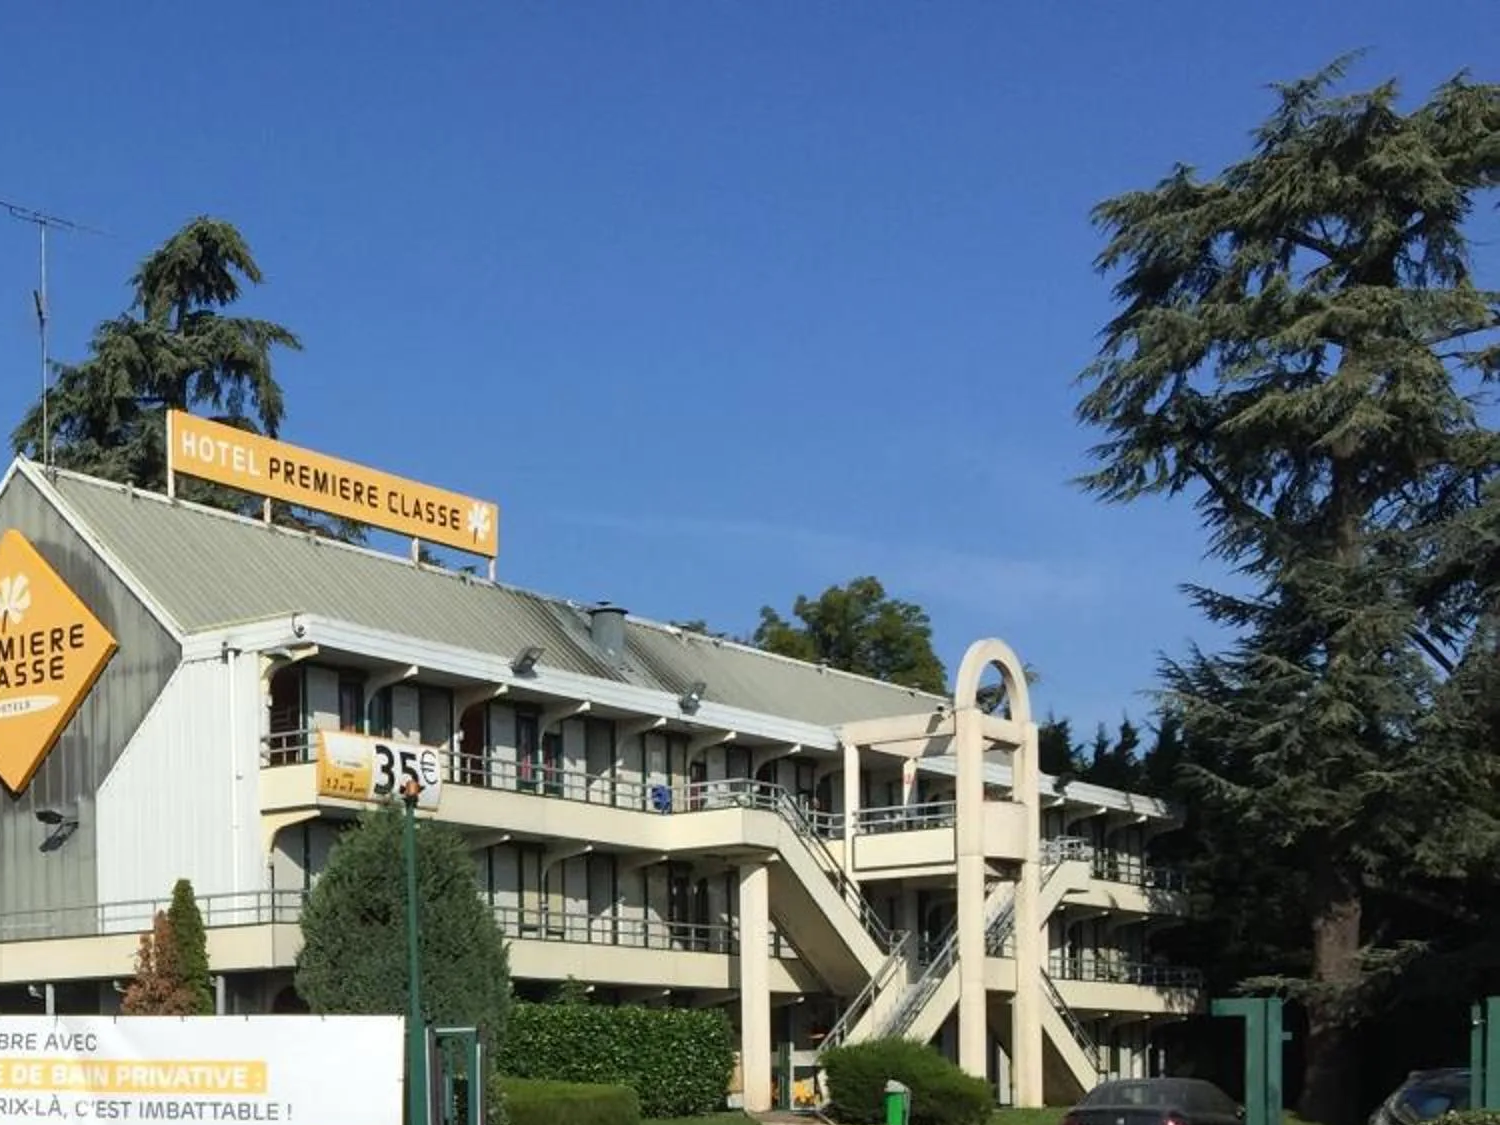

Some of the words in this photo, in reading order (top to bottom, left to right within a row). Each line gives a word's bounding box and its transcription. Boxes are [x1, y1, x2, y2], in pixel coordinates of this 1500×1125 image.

[181, 430, 261, 477] HOTEL
[269, 456, 379, 509] PREMIERE
[387, 490, 460, 531] CLASSE
[44, 1033, 98, 1051] AVEC
[11, 1065, 44, 1085] DE
[52, 1064, 110, 1087] BAIN
[116, 1065, 249, 1089] PRIVATIVE
[75, 1100, 132, 1119] C'EST
[139, 1101, 279, 1121] IMBATTABLE
